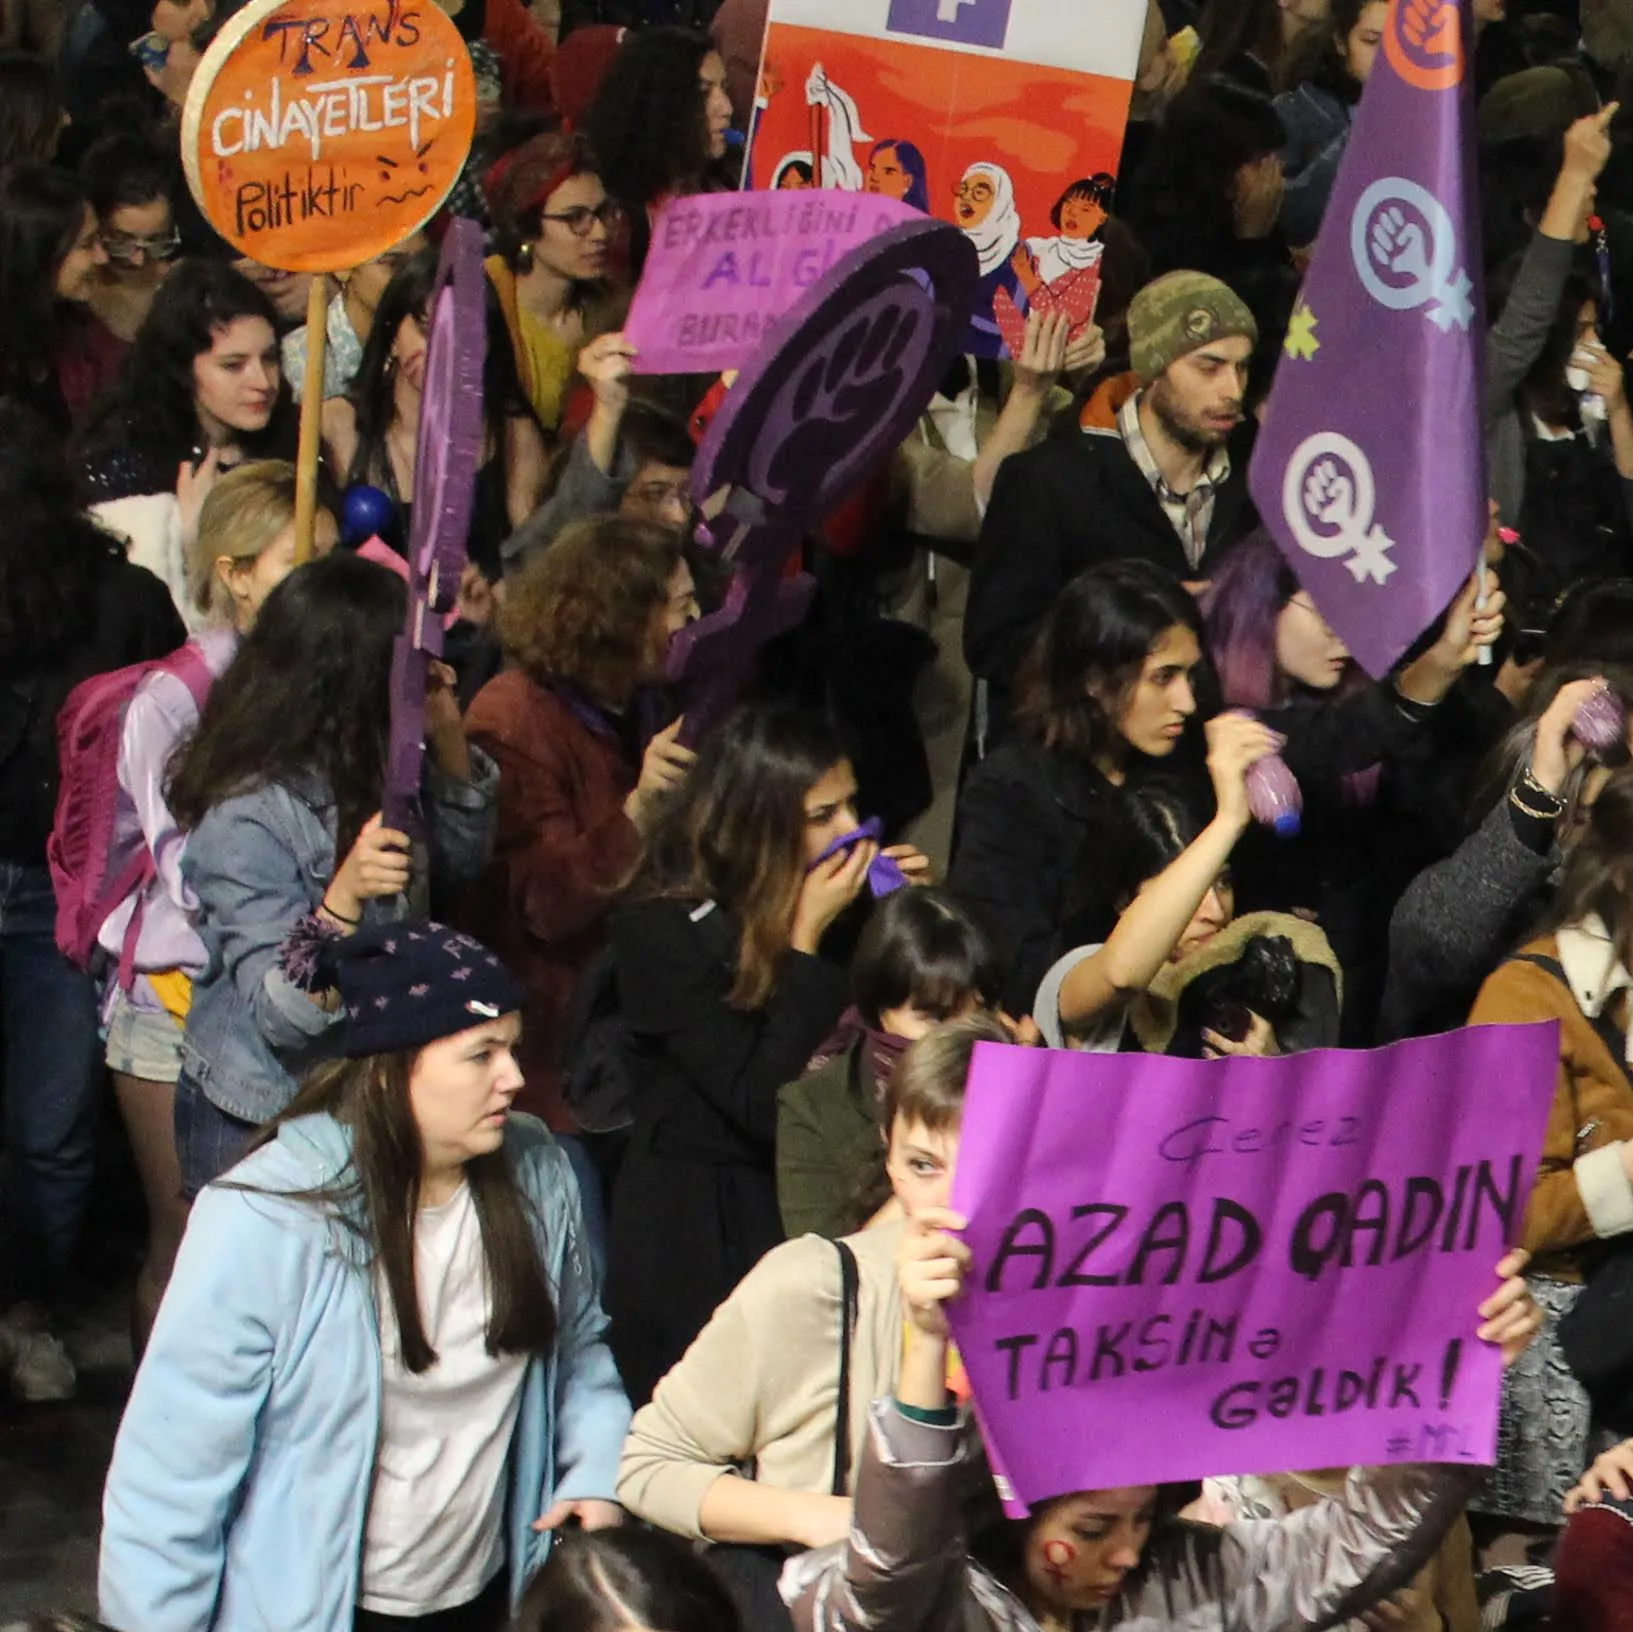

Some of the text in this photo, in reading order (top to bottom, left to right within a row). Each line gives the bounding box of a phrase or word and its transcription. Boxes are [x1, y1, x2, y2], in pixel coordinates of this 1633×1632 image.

[268, 11, 421, 74] TRANS
[701, 250, 771, 290] AL
[985, 1196, 1262, 1295] AZAD
